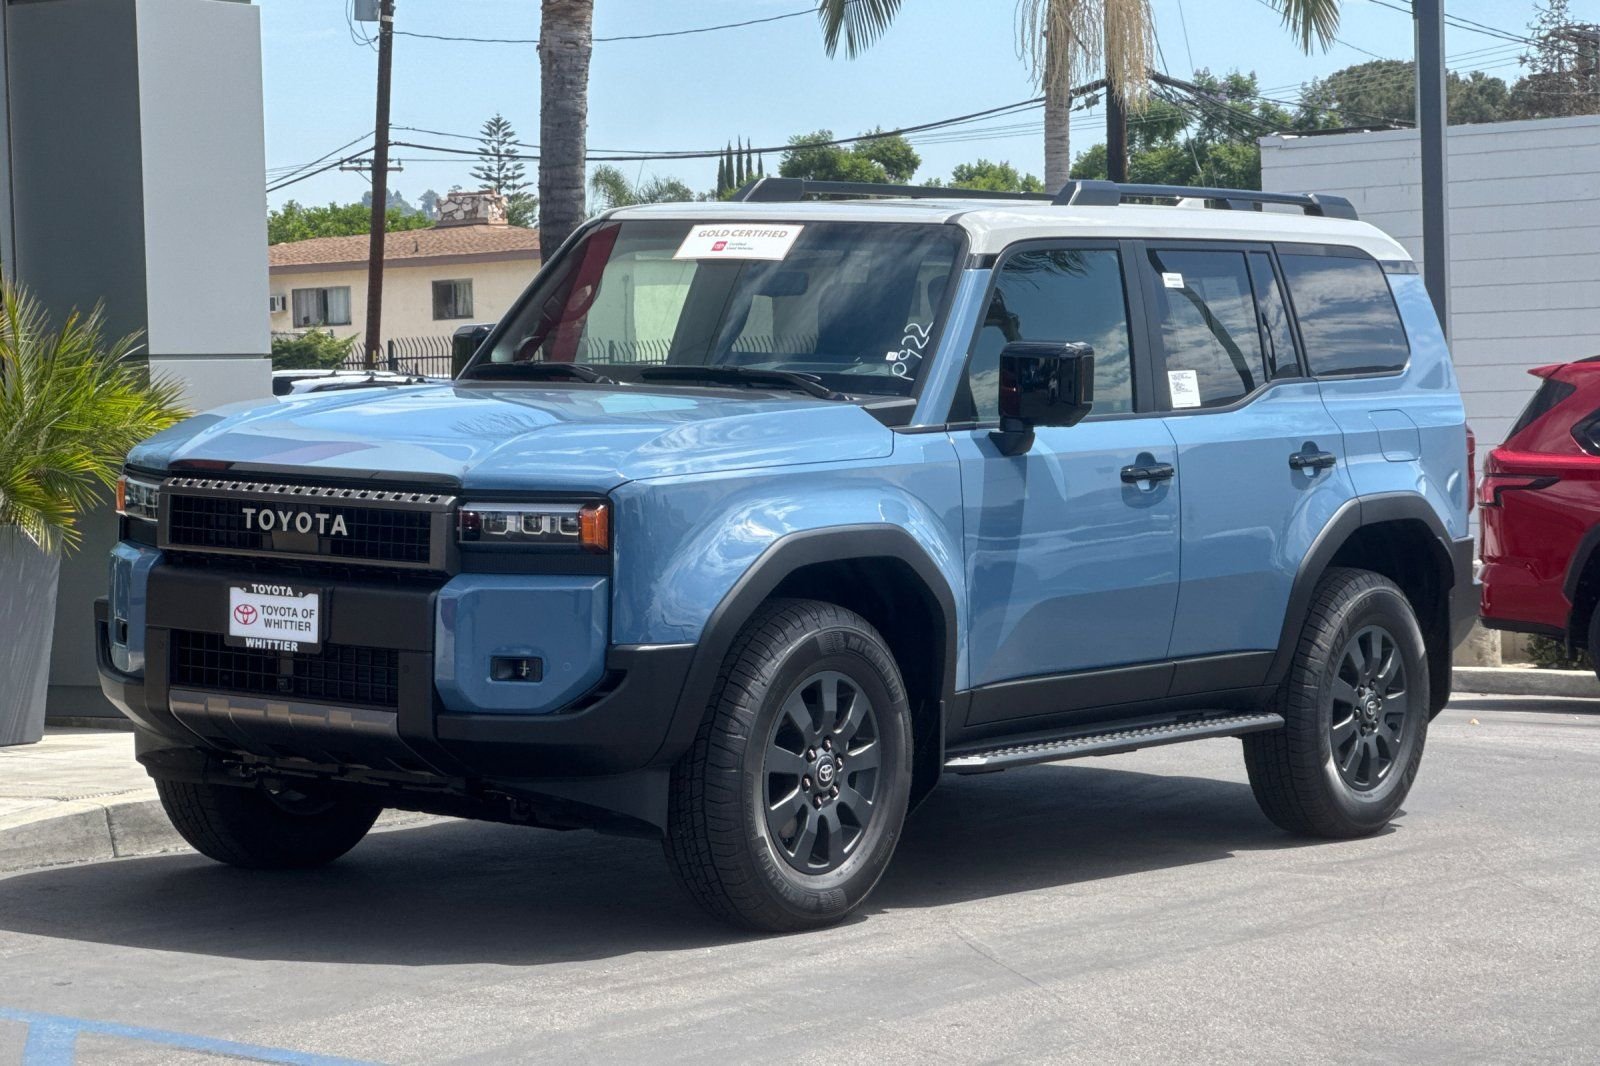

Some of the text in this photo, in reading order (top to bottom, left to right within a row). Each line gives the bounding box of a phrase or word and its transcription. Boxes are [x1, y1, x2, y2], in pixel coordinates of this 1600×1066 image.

[697, 229, 788, 238] GOLD CERTIFIED
[242, 507, 348, 536] TOYOTA
[251, 583, 294, 597] TOYOTA
[260, 604, 316, 619] TOYOTA OF
[263, 618, 312, 632] WHITTIER
[245, 637, 298, 652] WHITTIER
